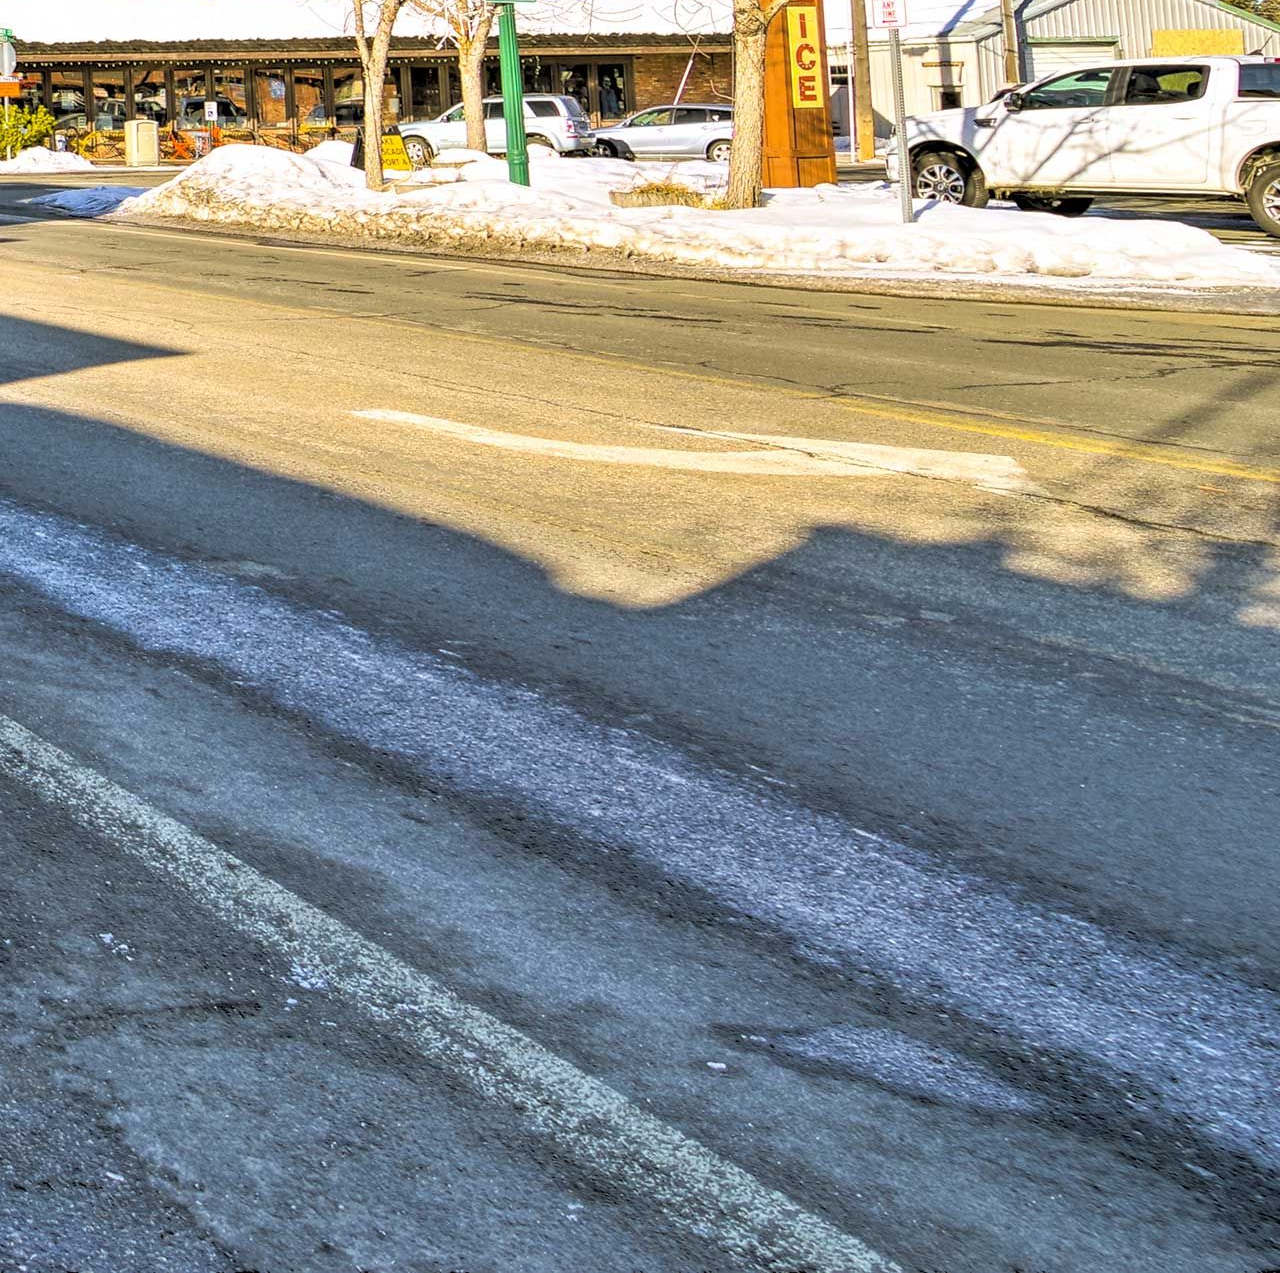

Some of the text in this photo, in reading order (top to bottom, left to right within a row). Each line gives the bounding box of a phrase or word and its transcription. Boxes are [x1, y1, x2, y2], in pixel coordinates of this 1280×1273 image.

[882, 1, 895, 9] ANY
[882, 10, 897, 19] TIME
[795, 13, 817, 102] ICE
